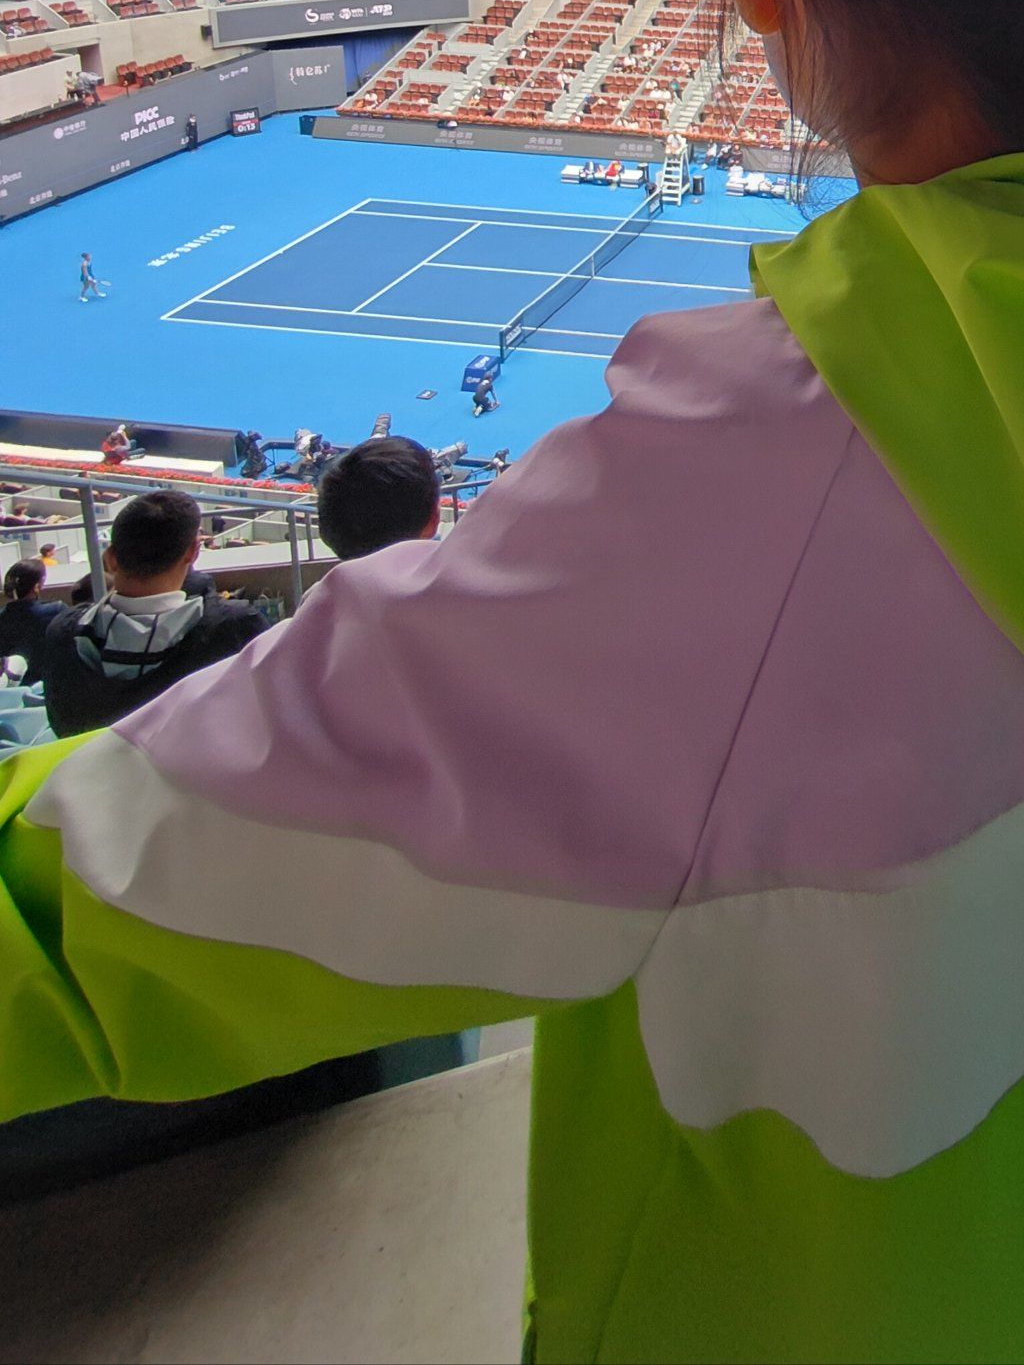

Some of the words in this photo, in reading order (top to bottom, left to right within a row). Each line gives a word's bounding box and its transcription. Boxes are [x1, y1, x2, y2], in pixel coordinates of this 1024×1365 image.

[134, 106, 160, 125] PICC
[121, 115, 175, 142] 中国人民保险
